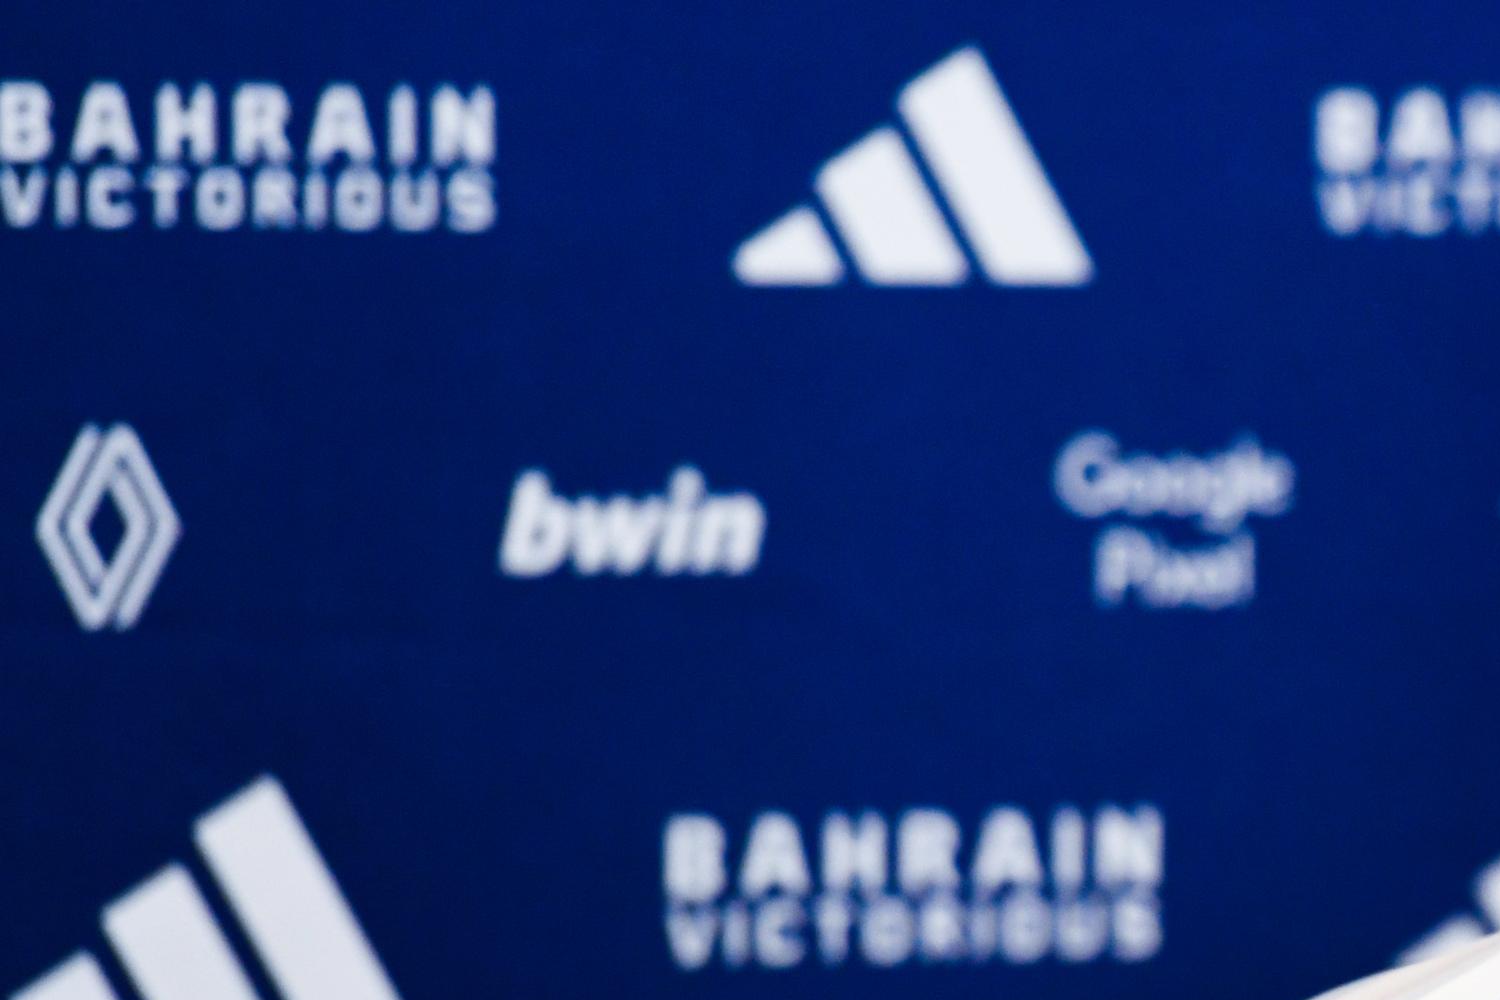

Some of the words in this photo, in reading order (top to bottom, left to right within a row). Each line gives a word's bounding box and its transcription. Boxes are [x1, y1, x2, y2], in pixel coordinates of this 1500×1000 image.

[0, 82, 495, 164] BAHRAIN
[0, 167, 496, 232] VICTORIOUS
[501, 467, 765, 576] bwin
[1055, 433, 1293, 530] Google
[664, 808, 1163, 897] BAHRAIN
[665, 897, 1162, 967] VICTORIOUS
